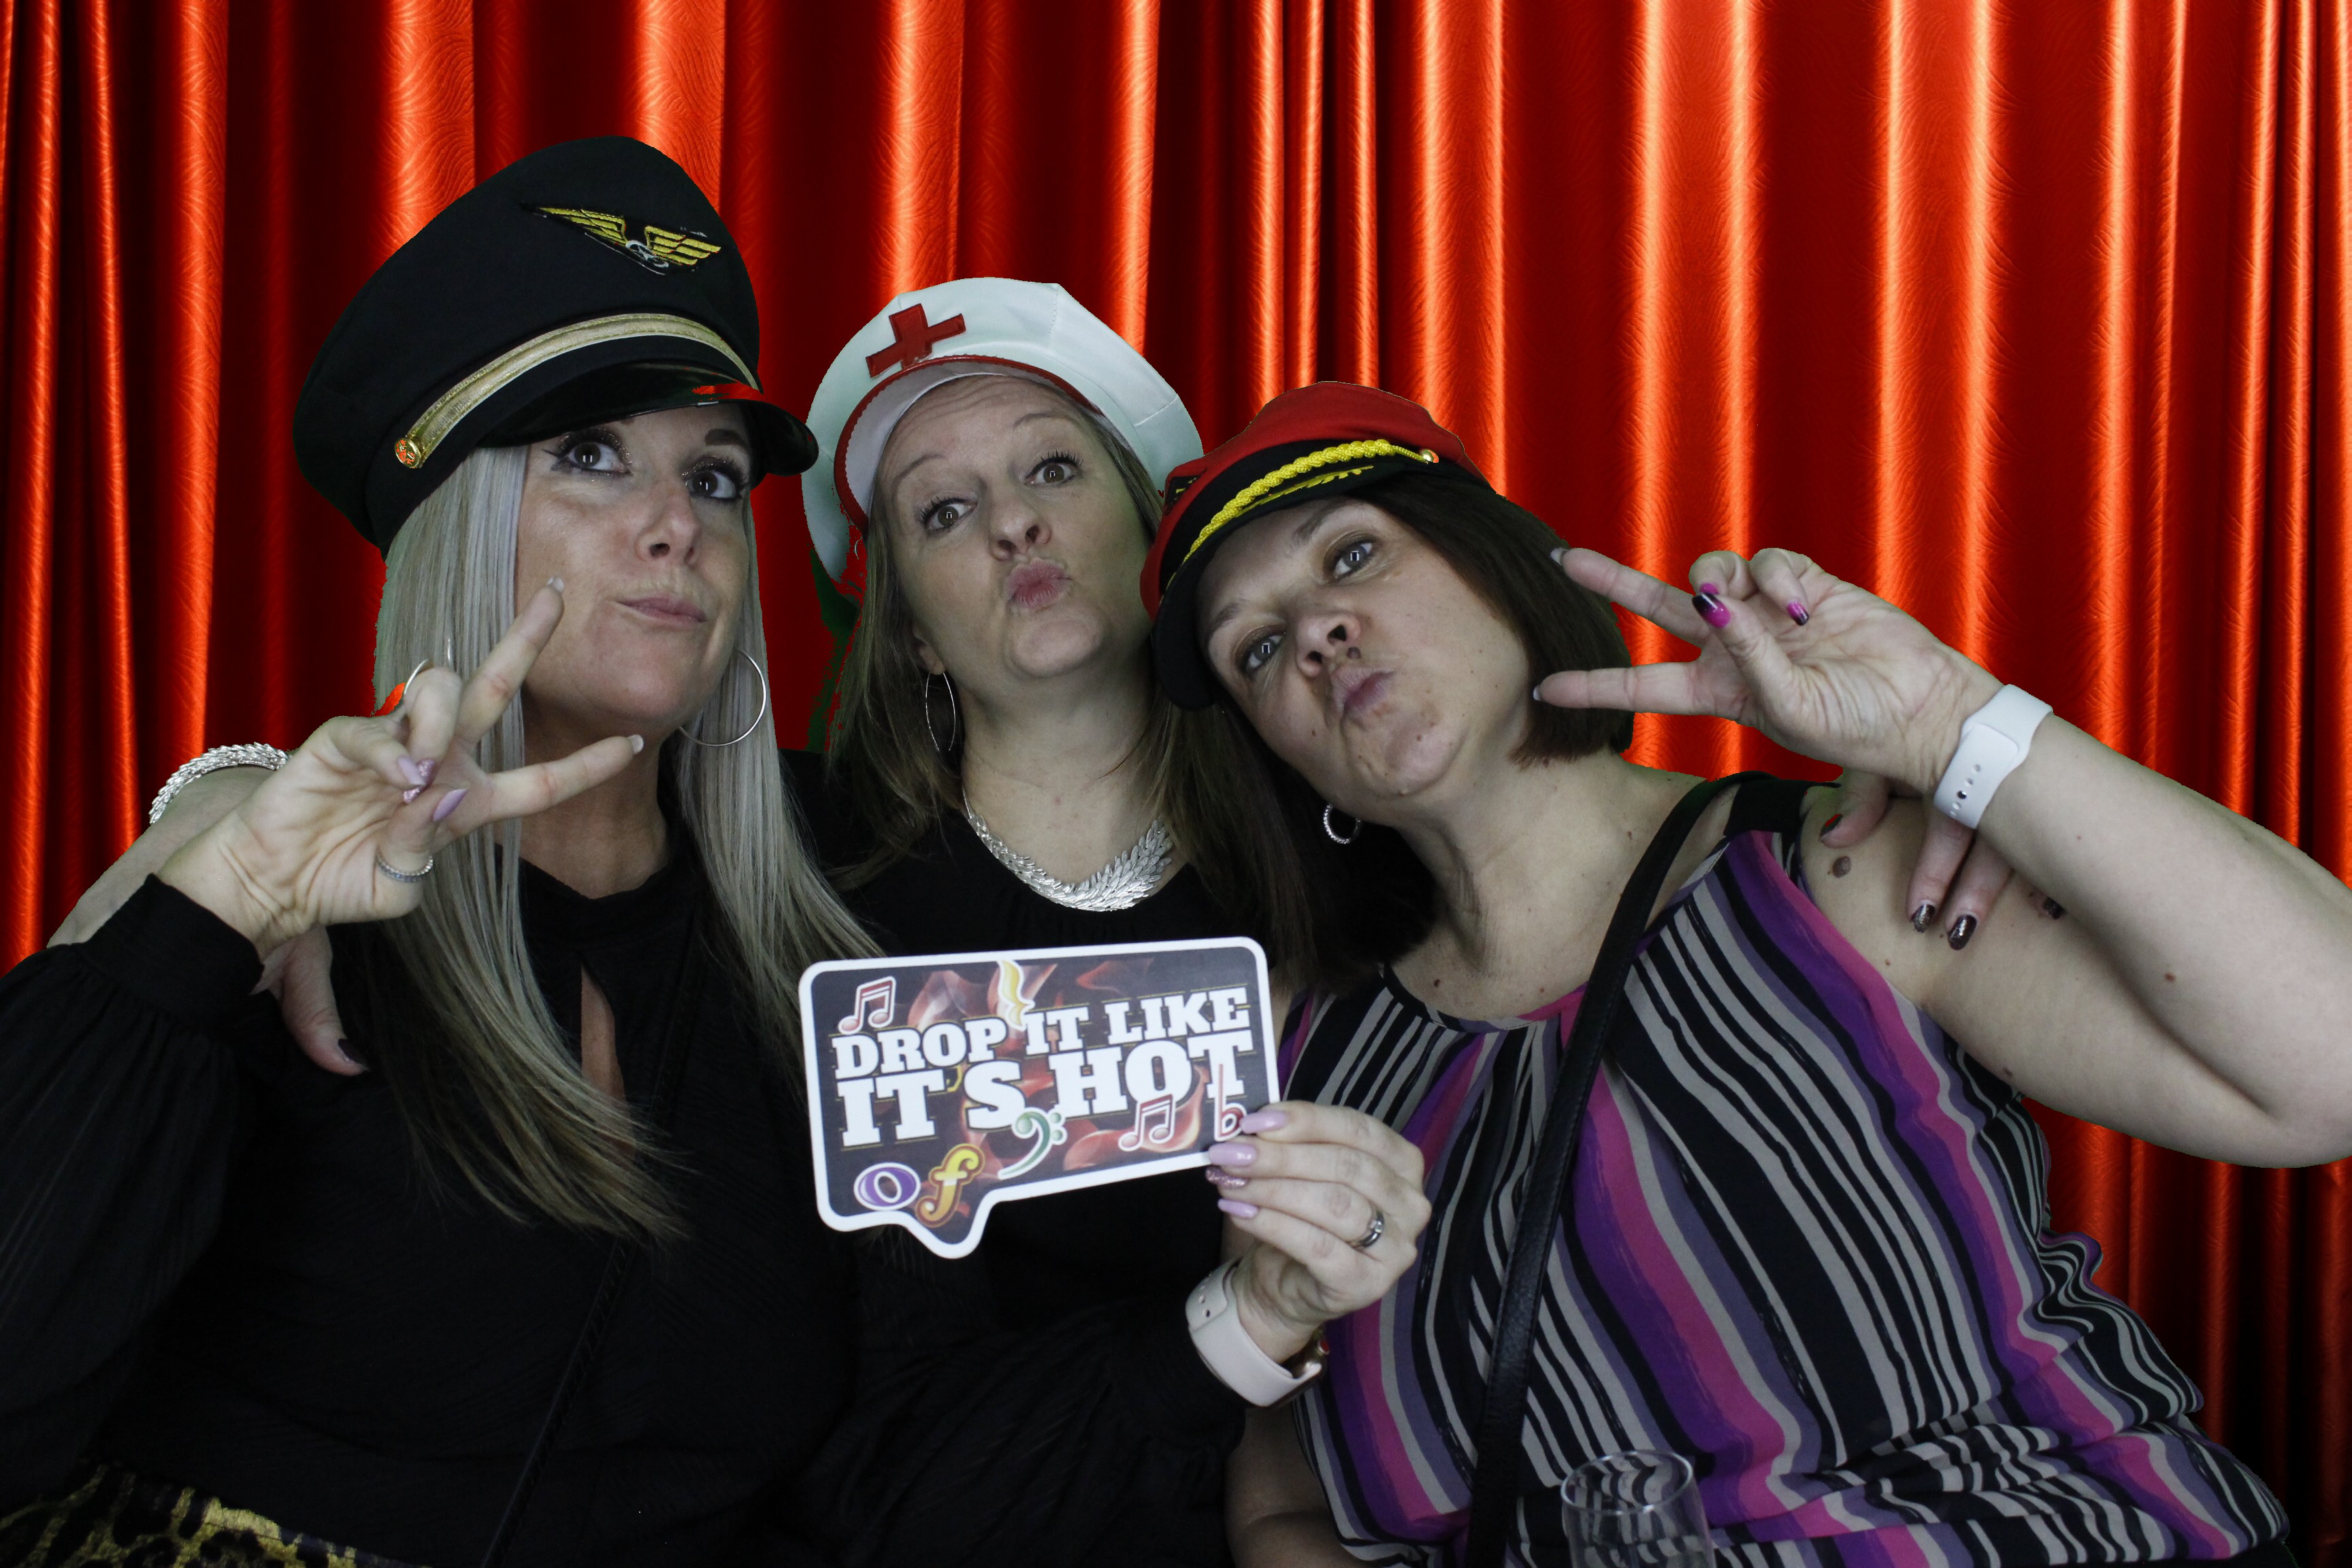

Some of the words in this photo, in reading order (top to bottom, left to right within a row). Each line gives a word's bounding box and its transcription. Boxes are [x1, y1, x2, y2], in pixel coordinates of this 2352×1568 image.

[832, 1017, 1007, 1079] DROP
[1024, 1007, 1089, 1056] IT
[1105, 987, 1250, 1045] LIKE
[837, 1060, 1026, 1147] IT'S
[1049, 1030, 1254, 1118] HOT
